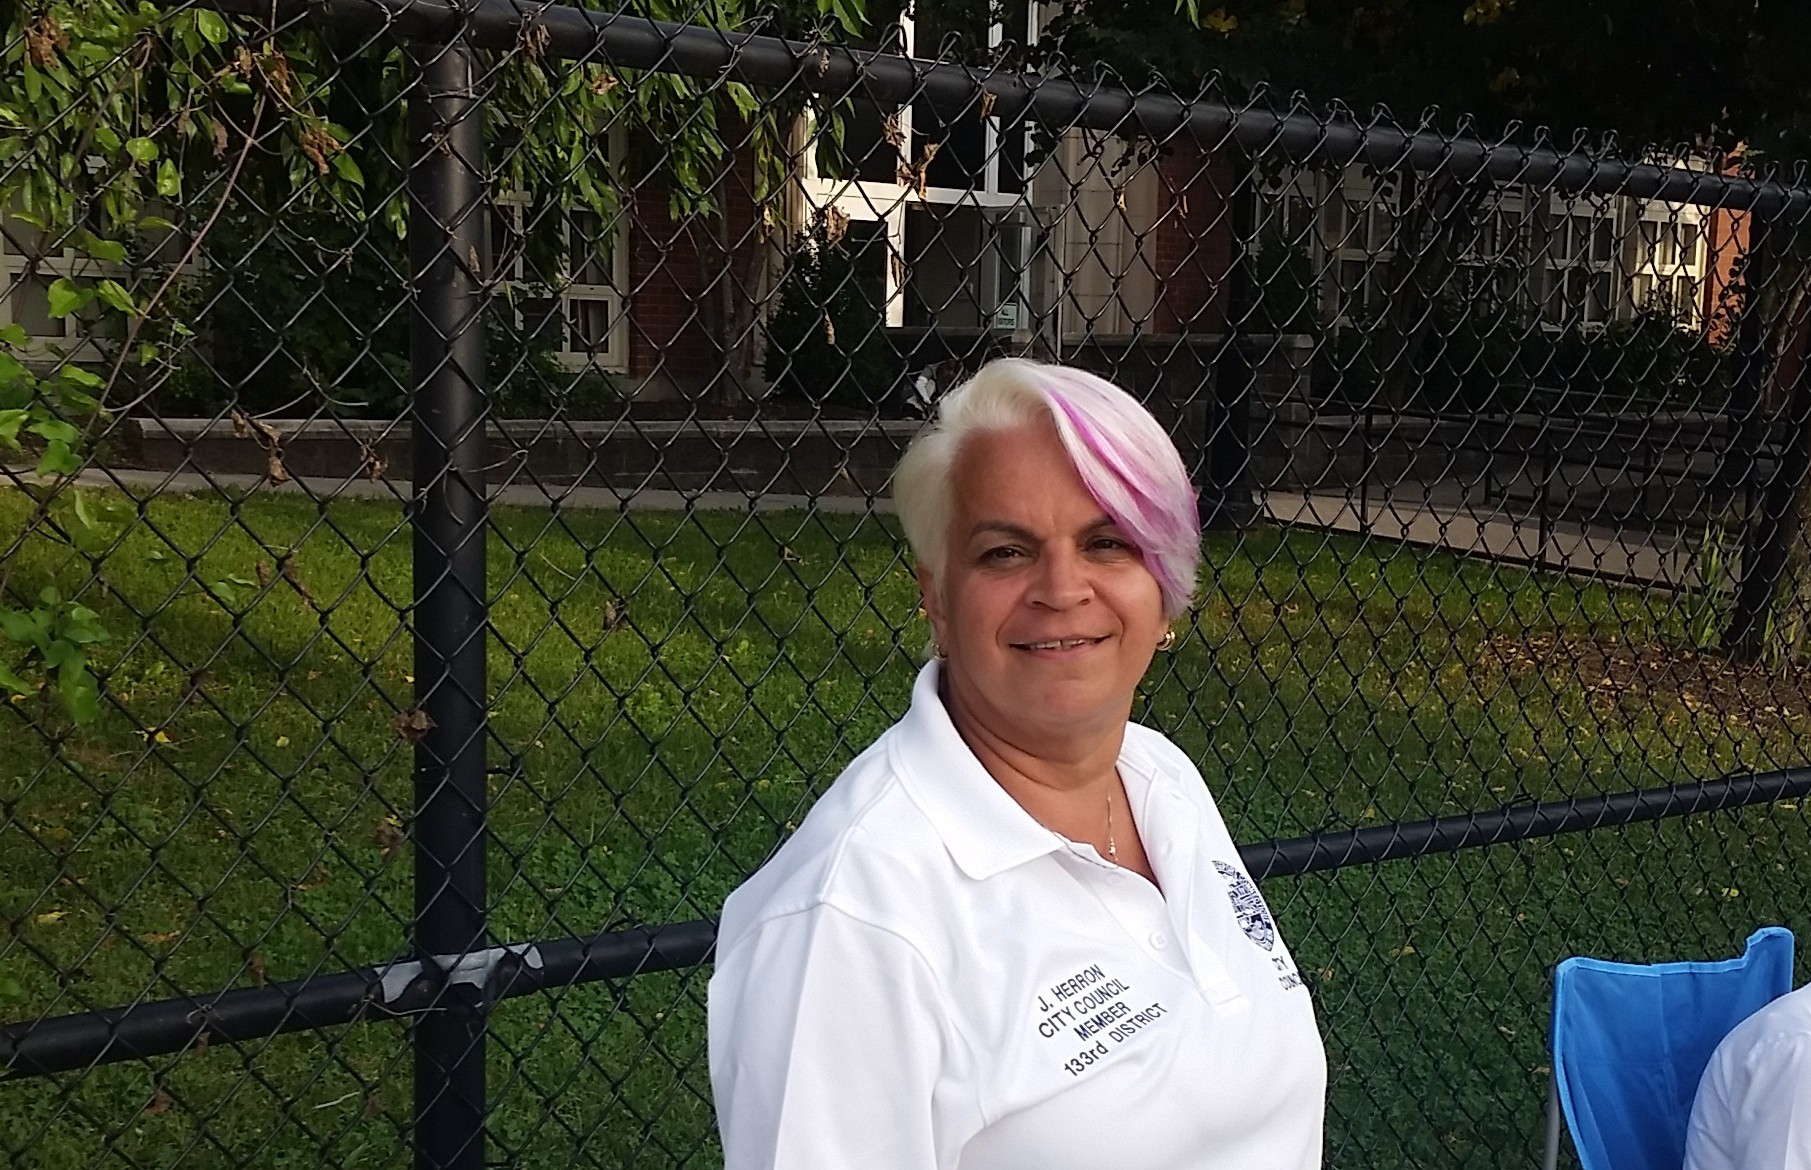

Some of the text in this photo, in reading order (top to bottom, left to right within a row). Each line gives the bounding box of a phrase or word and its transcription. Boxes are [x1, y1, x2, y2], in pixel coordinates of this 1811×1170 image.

[1038, 964, 1106, 1013] J. HERRON
[1038, 978, 1130, 1039] CITY COUNCIL
[1064, 1003, 1168, 1076] 133rd DISTRICT
[1073, 1001, 1131, 1041] MEMBER
